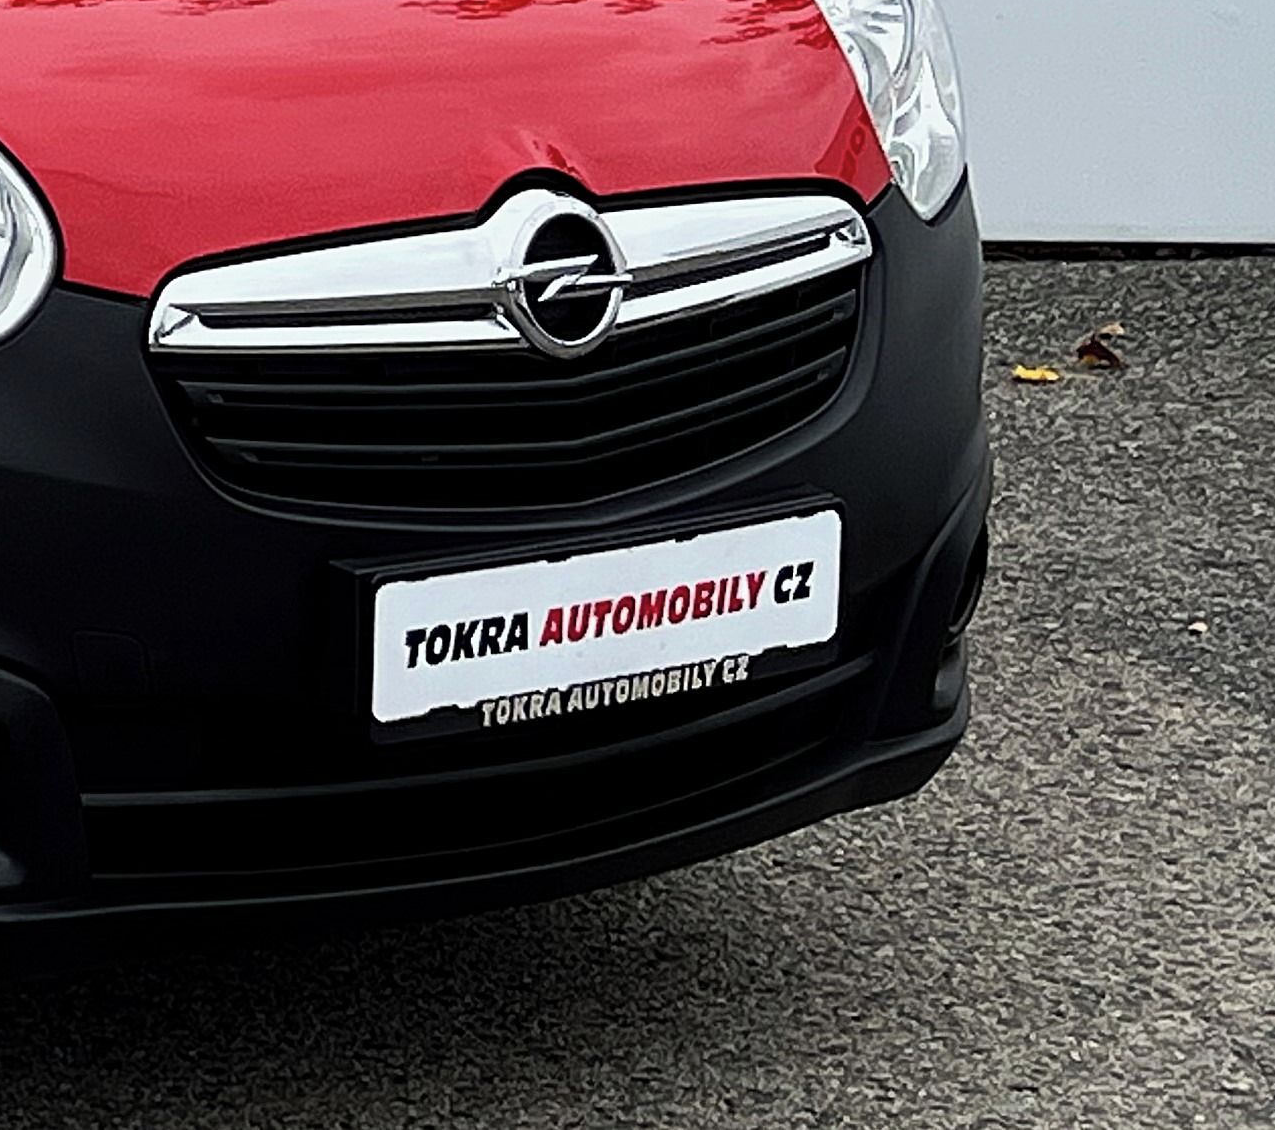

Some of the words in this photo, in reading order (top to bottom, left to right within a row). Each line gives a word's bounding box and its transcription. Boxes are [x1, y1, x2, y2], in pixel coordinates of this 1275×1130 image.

[404, 612, 530, 669] TOKRA
[539, 569, 770, 648] AUTOMOBILY
[772, 561, 816, 606] CZ
[481, 689, 562, 728] TOKRA
[566, 661, 717, 714] AUTOMOBILY
[721, 654, 750, 684] CZ
